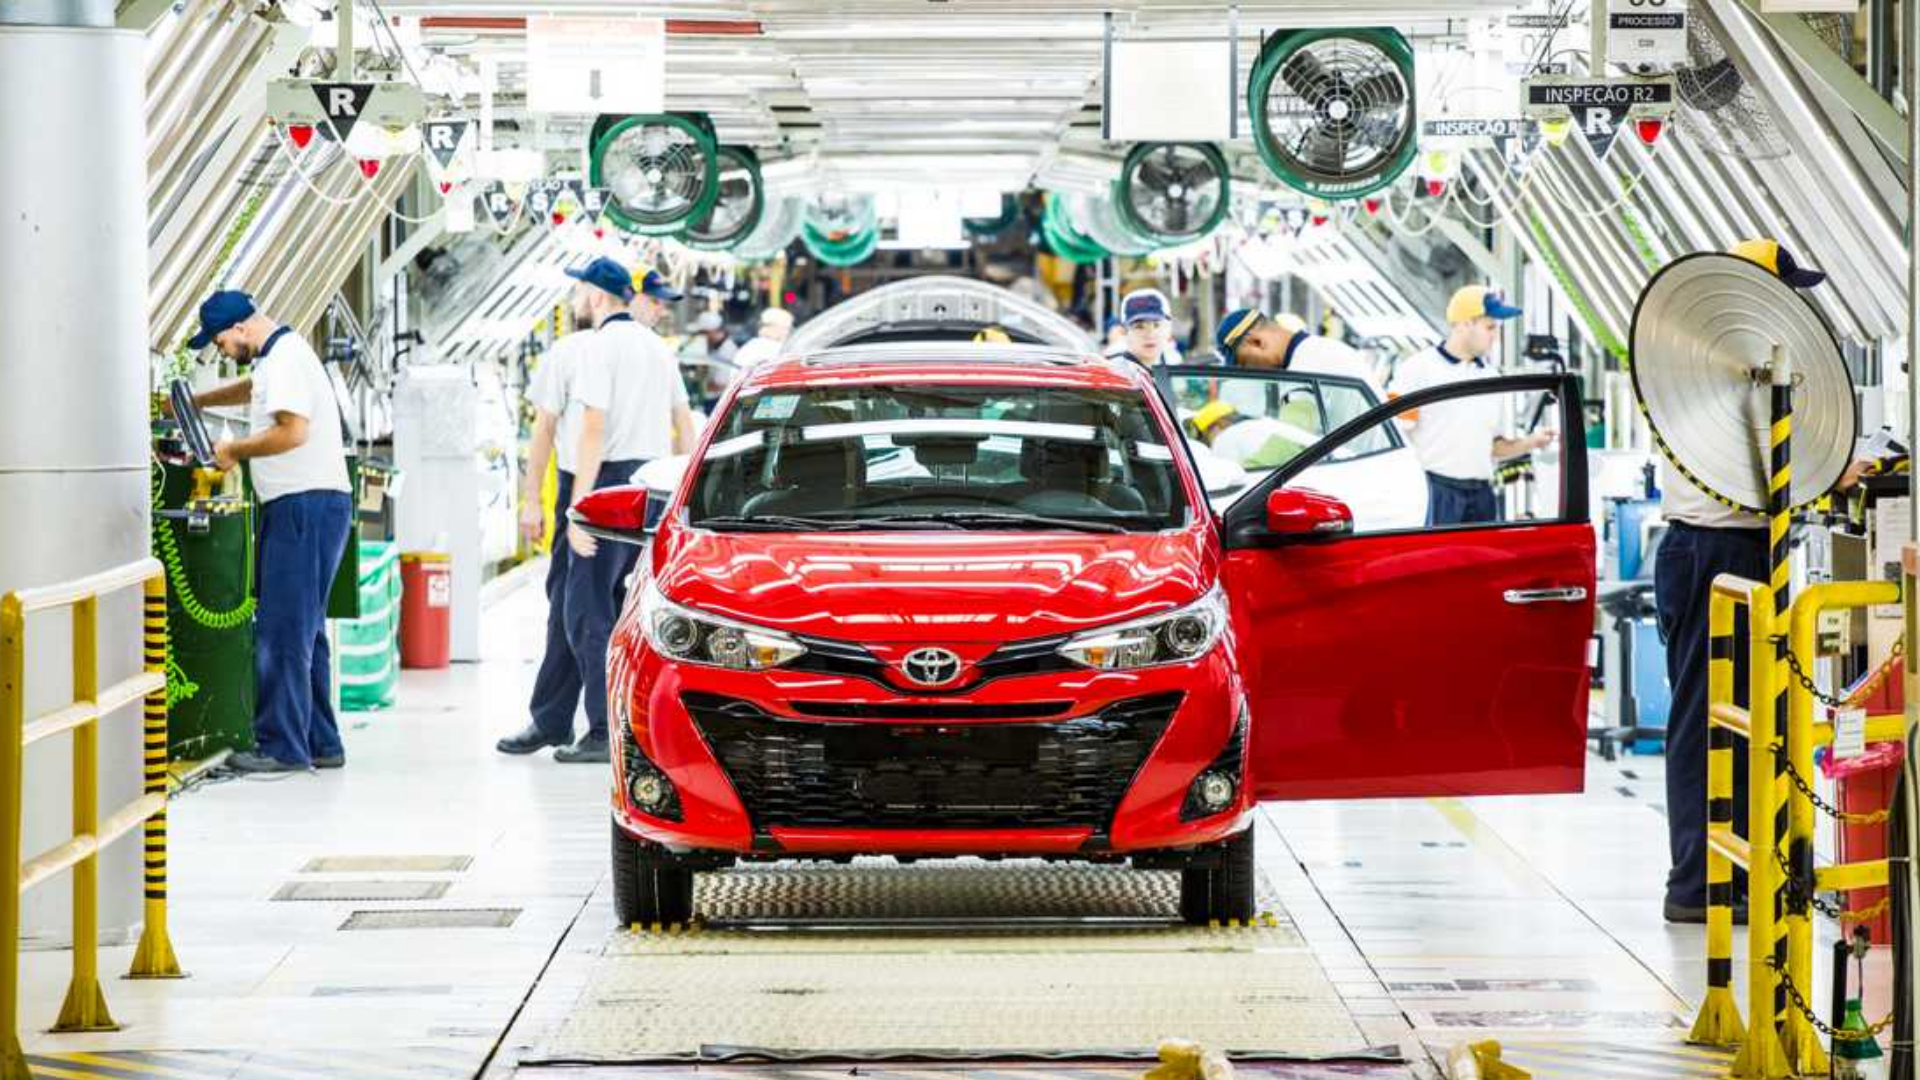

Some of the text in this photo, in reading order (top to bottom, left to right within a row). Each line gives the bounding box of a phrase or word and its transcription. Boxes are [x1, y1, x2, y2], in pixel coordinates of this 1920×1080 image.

[329, 87, 357, 117] R
[1545, 83, 1655, 104] INSPEÇÃO R2
[1585, 106, 1613, 135] R
[430, 125, 455, 150] R
